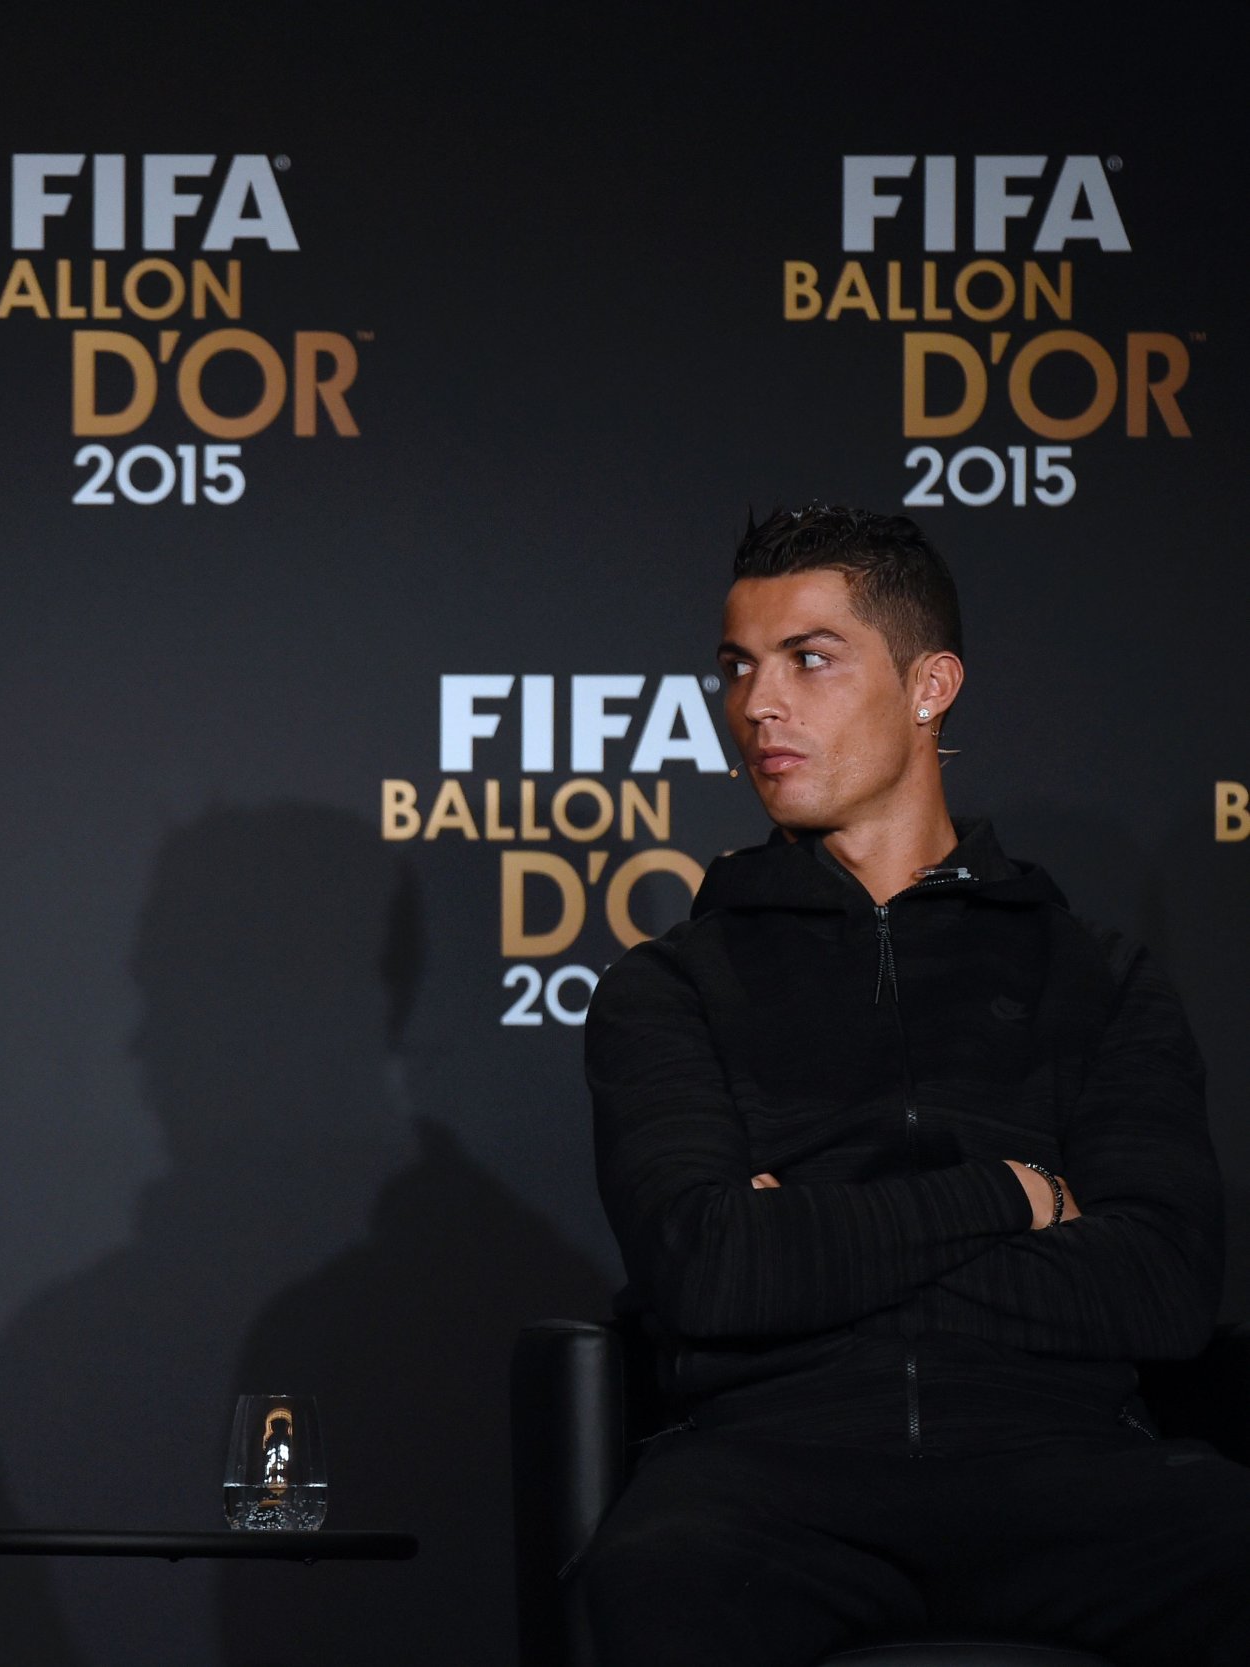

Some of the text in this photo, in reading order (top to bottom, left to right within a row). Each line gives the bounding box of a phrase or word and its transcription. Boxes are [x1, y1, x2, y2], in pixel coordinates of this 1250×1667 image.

[11, 153, 301, 252] FIFA
[842, 155, 1132, 252] FIFA
[784, 259, 1072, 322] BALLON
[72, 328, 361, 440] D'OR
[903, 330, 1191, 440] D'OR
[71, 443, 247, 506] 2015
[902, 445, 1077, 507] 2015
[438, 673, 730, 774] FIFA
[380, 777, 671, 843] BALLON
[500, 847, 734, 958] D'O
[499, 963, 612, 1027] 20
